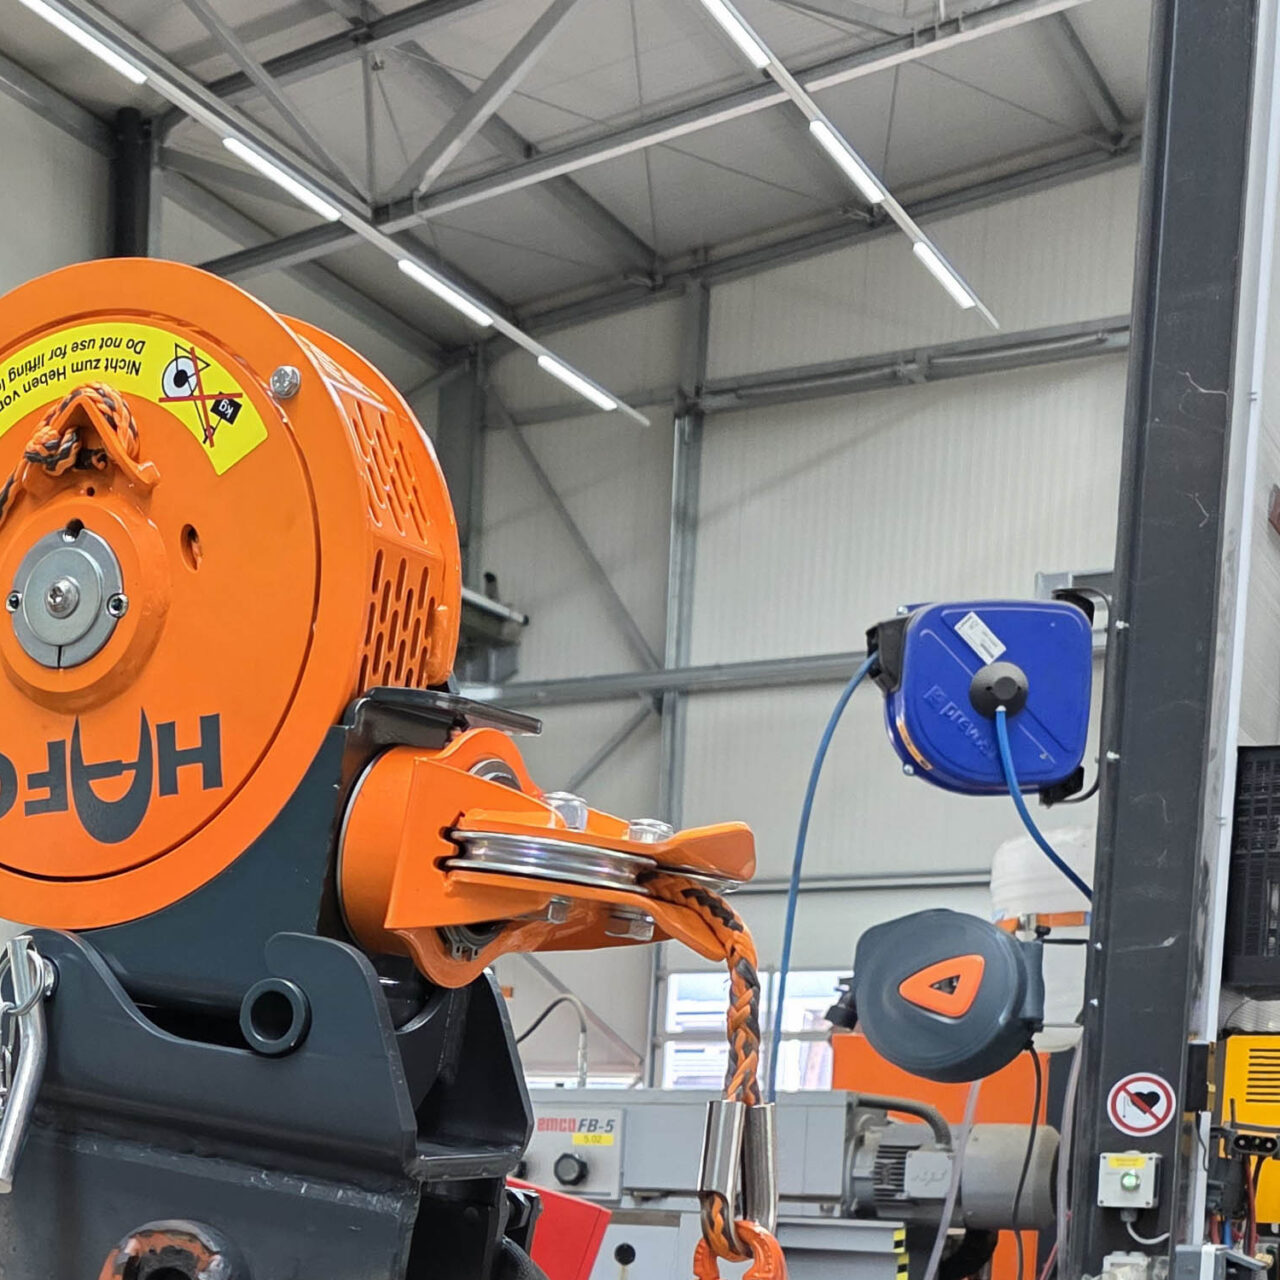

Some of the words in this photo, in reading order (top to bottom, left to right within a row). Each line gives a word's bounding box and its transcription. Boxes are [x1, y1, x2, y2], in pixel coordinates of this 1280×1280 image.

[71, 337, 96, 352] use
[100, 336, 123, 349] not
[126, 338, 146, 355] Do
[48, 344, 68, 361] for
[8, 352, 46, 383] lifting
[71, 358, 102, 374] zum
[105, 357, 142, 377] Nicht
[23, 365, 68, 390] Heben
[218, 400, 234, 419] kg
[577, 1118, 616, 1133] FB-5
